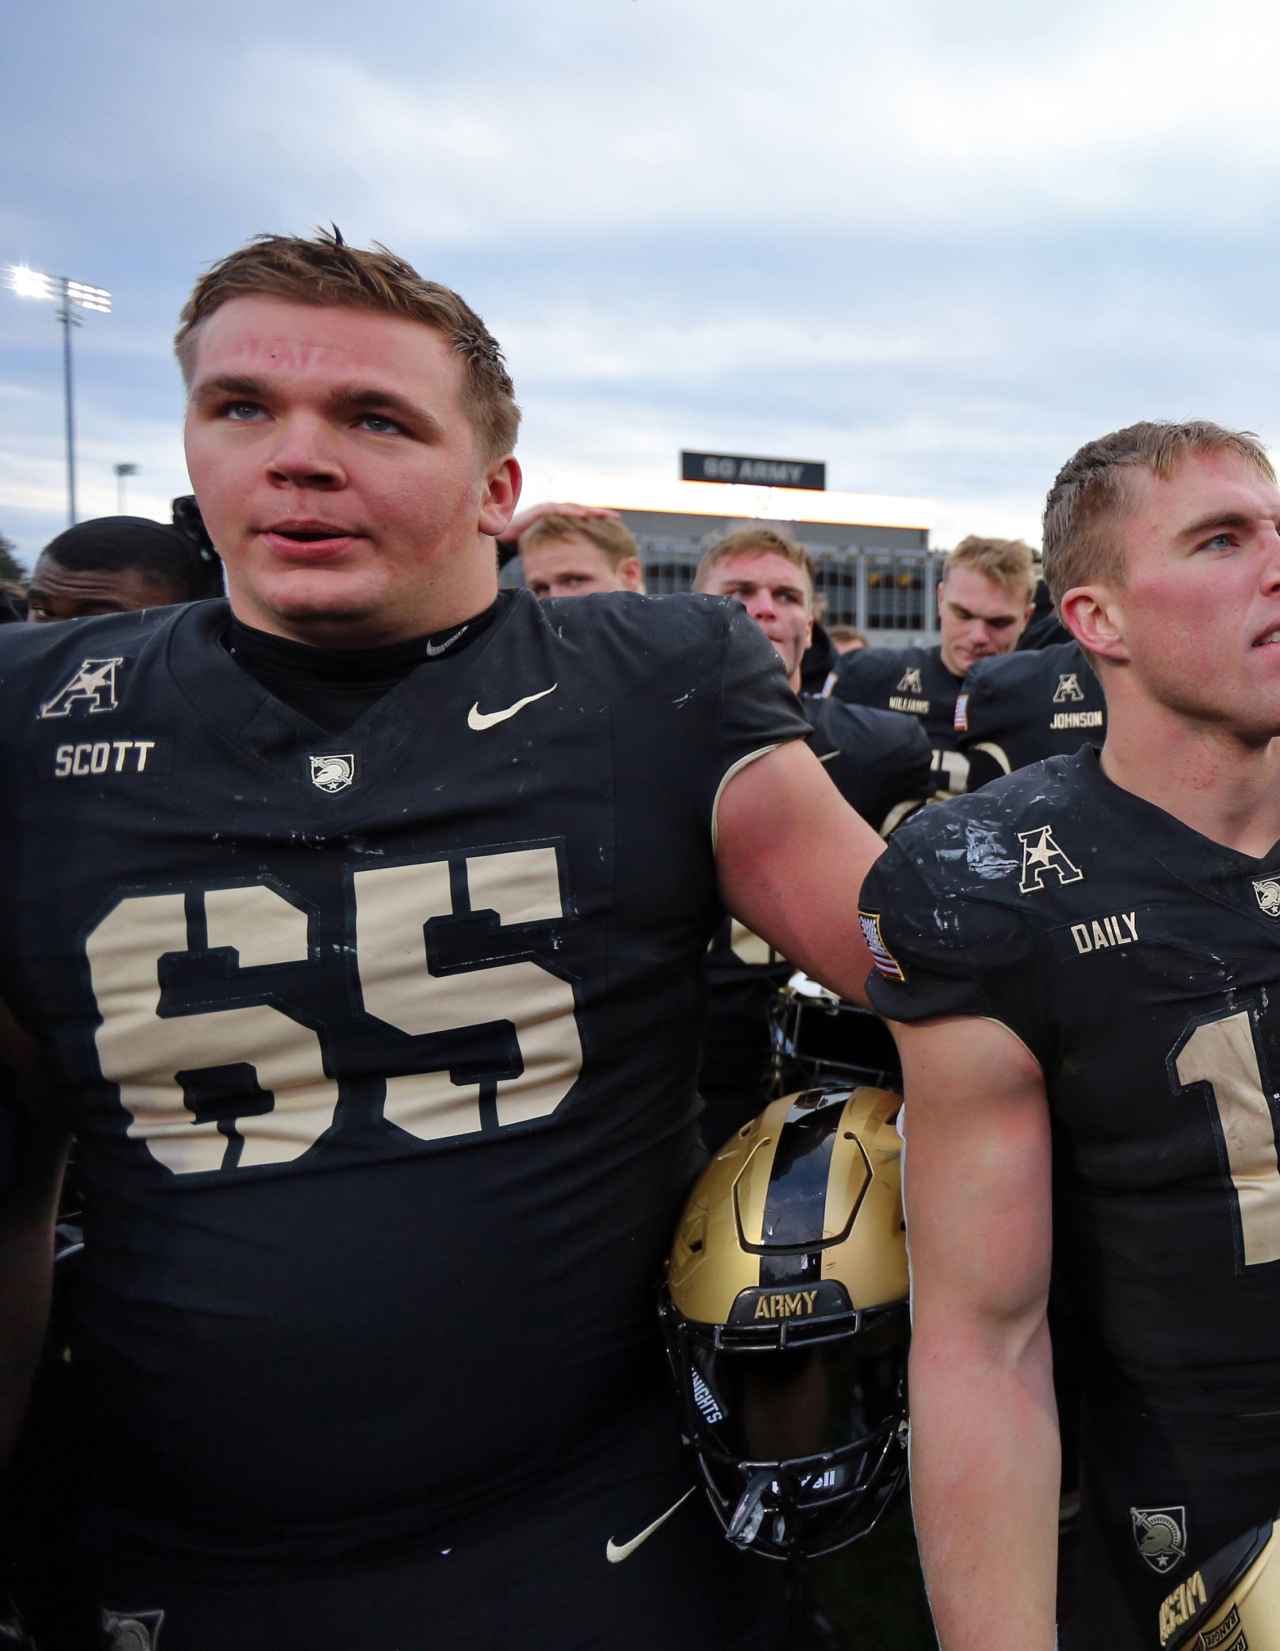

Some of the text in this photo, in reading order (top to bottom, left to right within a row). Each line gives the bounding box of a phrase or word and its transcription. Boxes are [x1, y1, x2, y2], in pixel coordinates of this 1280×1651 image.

[703, 456, 804, 483] GO ARMY
[889, 697, 930, 715] WILLIAMS
[1050, 710, 1103, 730] JOHNSON
[55, 741, 156, 777] SCOTT
[1070, 911, 1140, 954] DAILY
[84, 846, 584, 1176] 65
[754, 1289, 818, 1320] ARMY
[1206, 1610, 1239, 1646] RANGER
